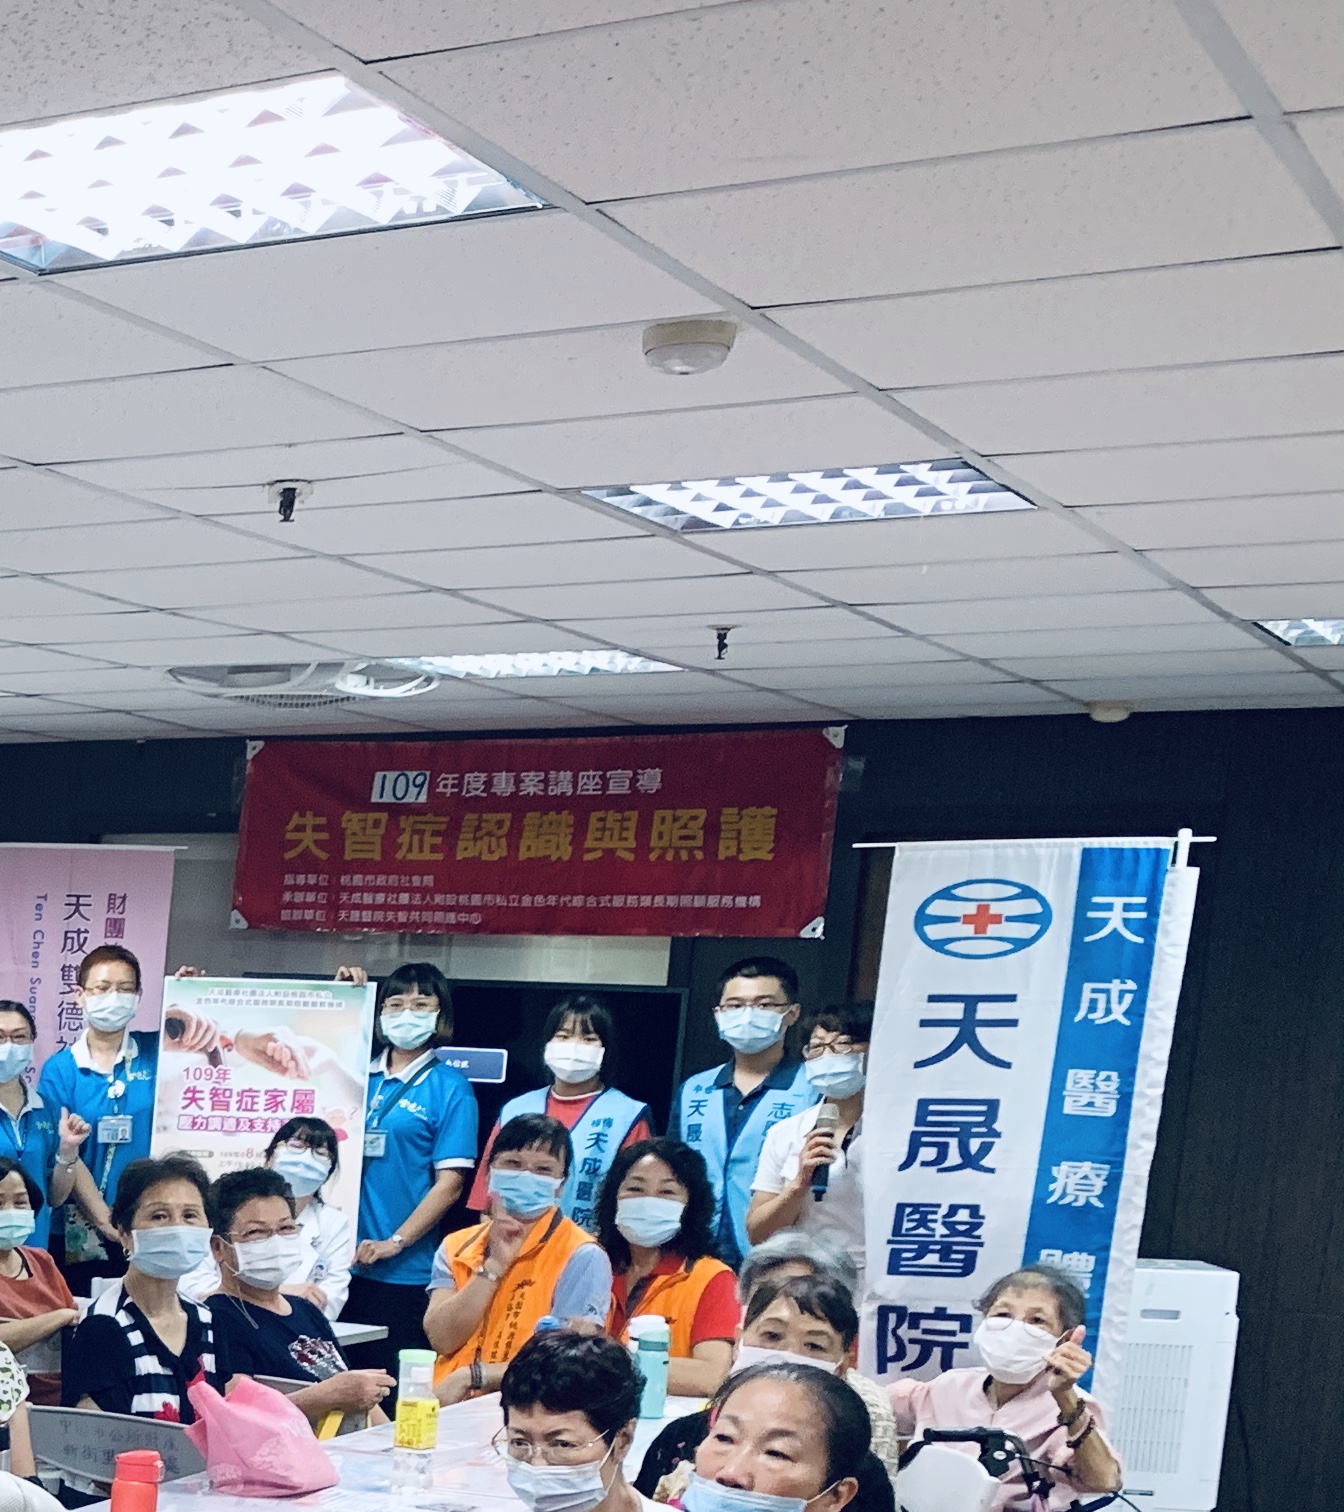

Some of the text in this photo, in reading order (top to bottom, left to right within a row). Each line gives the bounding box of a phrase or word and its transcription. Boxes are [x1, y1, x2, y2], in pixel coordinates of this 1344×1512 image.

[378, 768, 663, 801] 109 年度專案講座宣導
[283, 806, 778, 862] 失智症認識與照護
[34, 893, 48, 922] Ten
[104, 893, 127, 946] 財團
[31, 929, 45, 969] Chen
[183, 1067, 232, 1083] 109年
[181, 1085, 316, 1115] 失智症家屬
[177, 1114, 286, 1133] 壓力調適及支持
[875, 993, 1020, 1375] 天晟醫院
